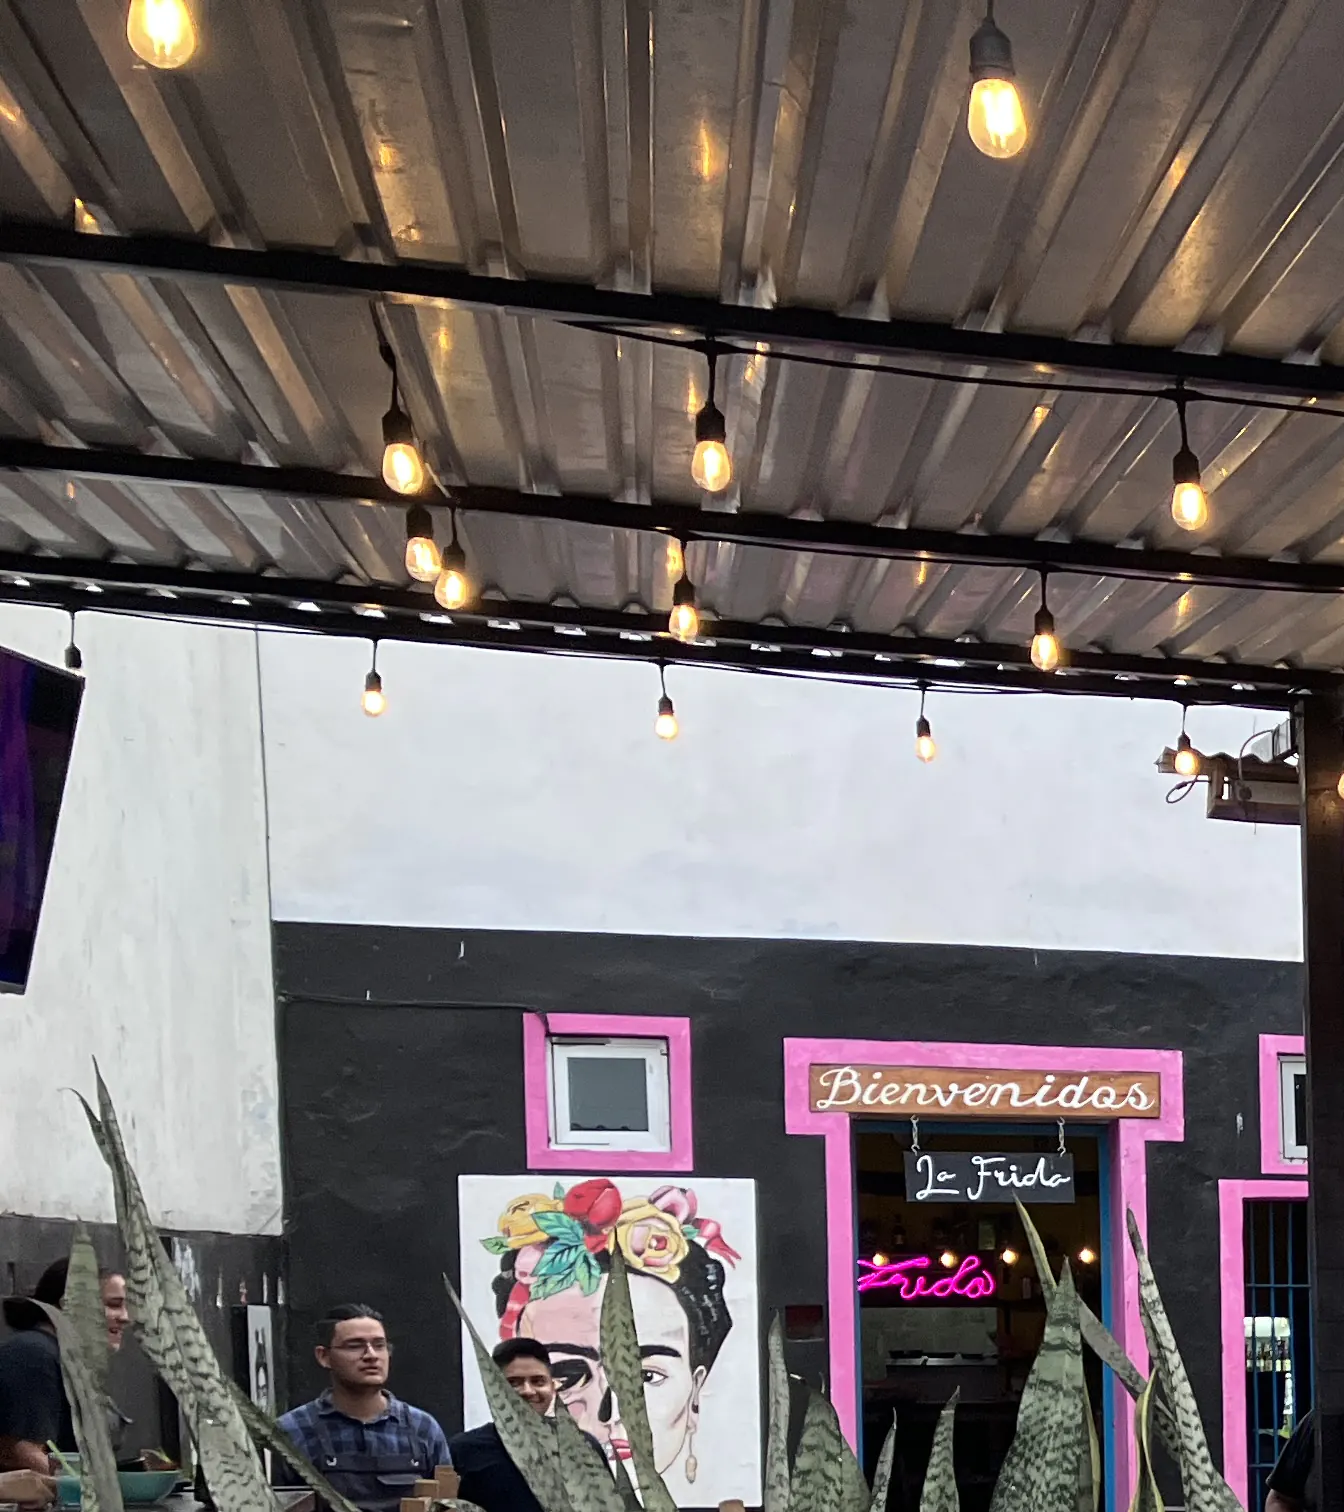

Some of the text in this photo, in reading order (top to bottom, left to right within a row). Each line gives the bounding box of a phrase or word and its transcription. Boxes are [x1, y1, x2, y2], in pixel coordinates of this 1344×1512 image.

[817, 1066, 1155, 1111] Bienvenidos
[916, 1154, 1071, 1200] La Frida
